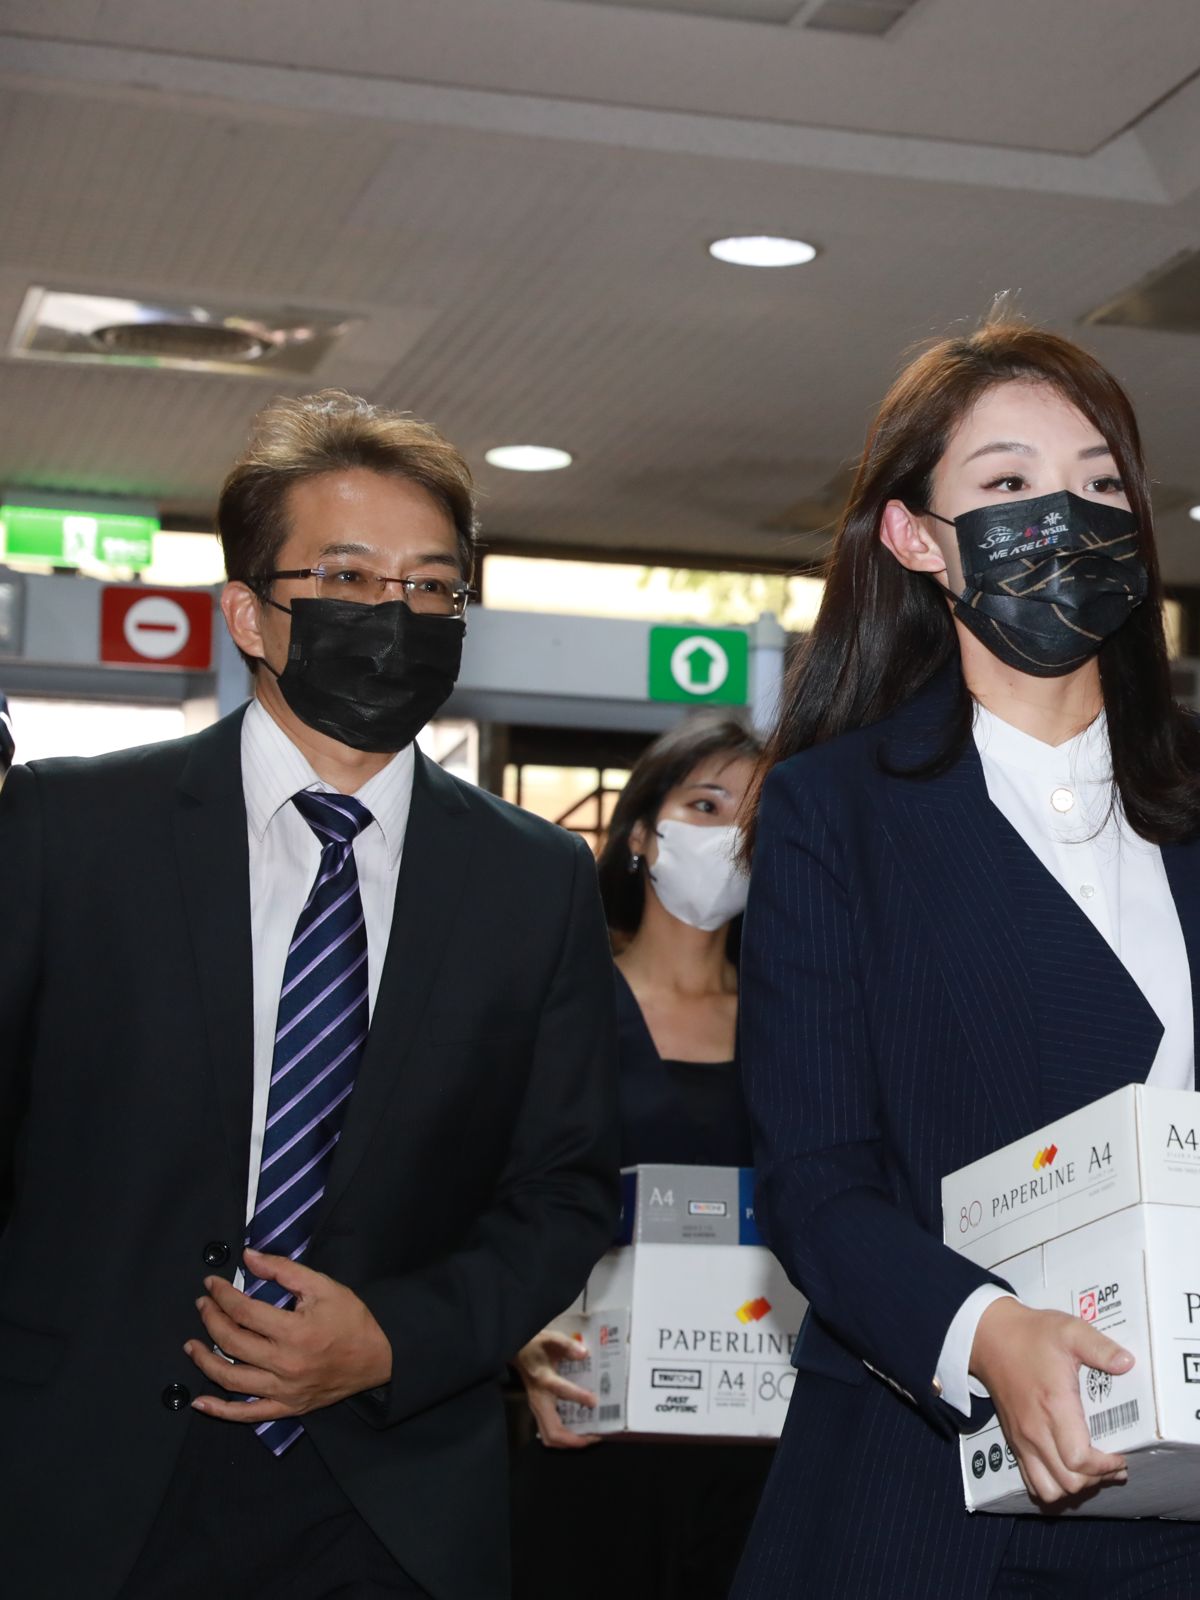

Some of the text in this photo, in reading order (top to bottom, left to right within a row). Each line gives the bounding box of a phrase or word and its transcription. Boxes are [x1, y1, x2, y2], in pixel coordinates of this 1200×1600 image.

[989, 549, 1009, 561] WE
[1010, 541, 1034, 556] ARE
[1167, 1124, 1200, 1151] A4
[650, 1186, 674, 1207] A4
[959, 1200, 983, 1234] 80
[991, 1161, 1076, 1217] PAPERLINE
[1088, 1142, 1113, 1174] A4
[1097, 1283, 1119, 1305] APP
[718, 1369, 745, 1390] A4
[655, 1404, 698, 1413] COPYING
[665, 1396, 689, 1404] FAST
